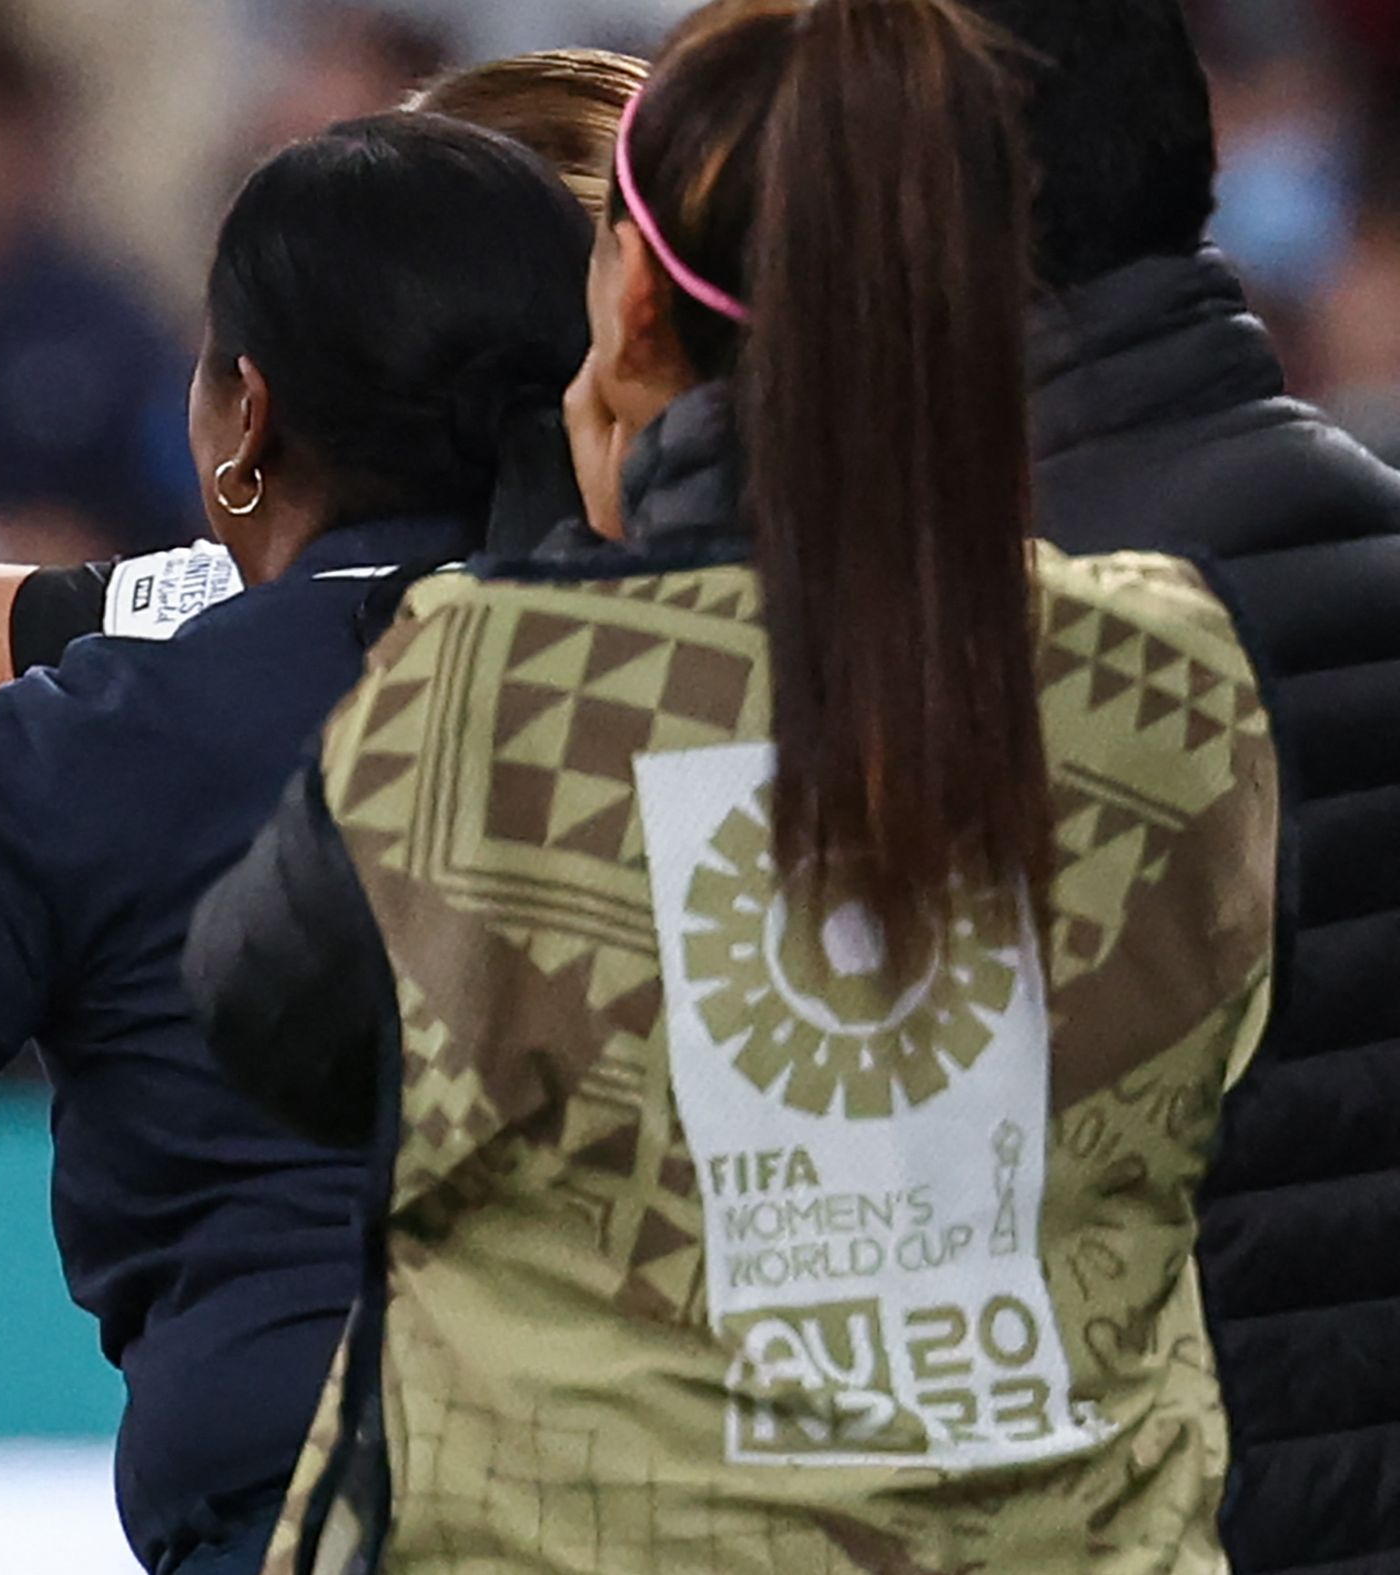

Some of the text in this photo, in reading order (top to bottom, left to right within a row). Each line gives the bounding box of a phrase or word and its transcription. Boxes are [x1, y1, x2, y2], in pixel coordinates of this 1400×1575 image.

[180, 553, 211, 614] UNITES
[708, 1145, 820, 1197] FIFA
[896, 1224, 973, 1272] CUP
[904, 1293, 1039, 1383] 20
